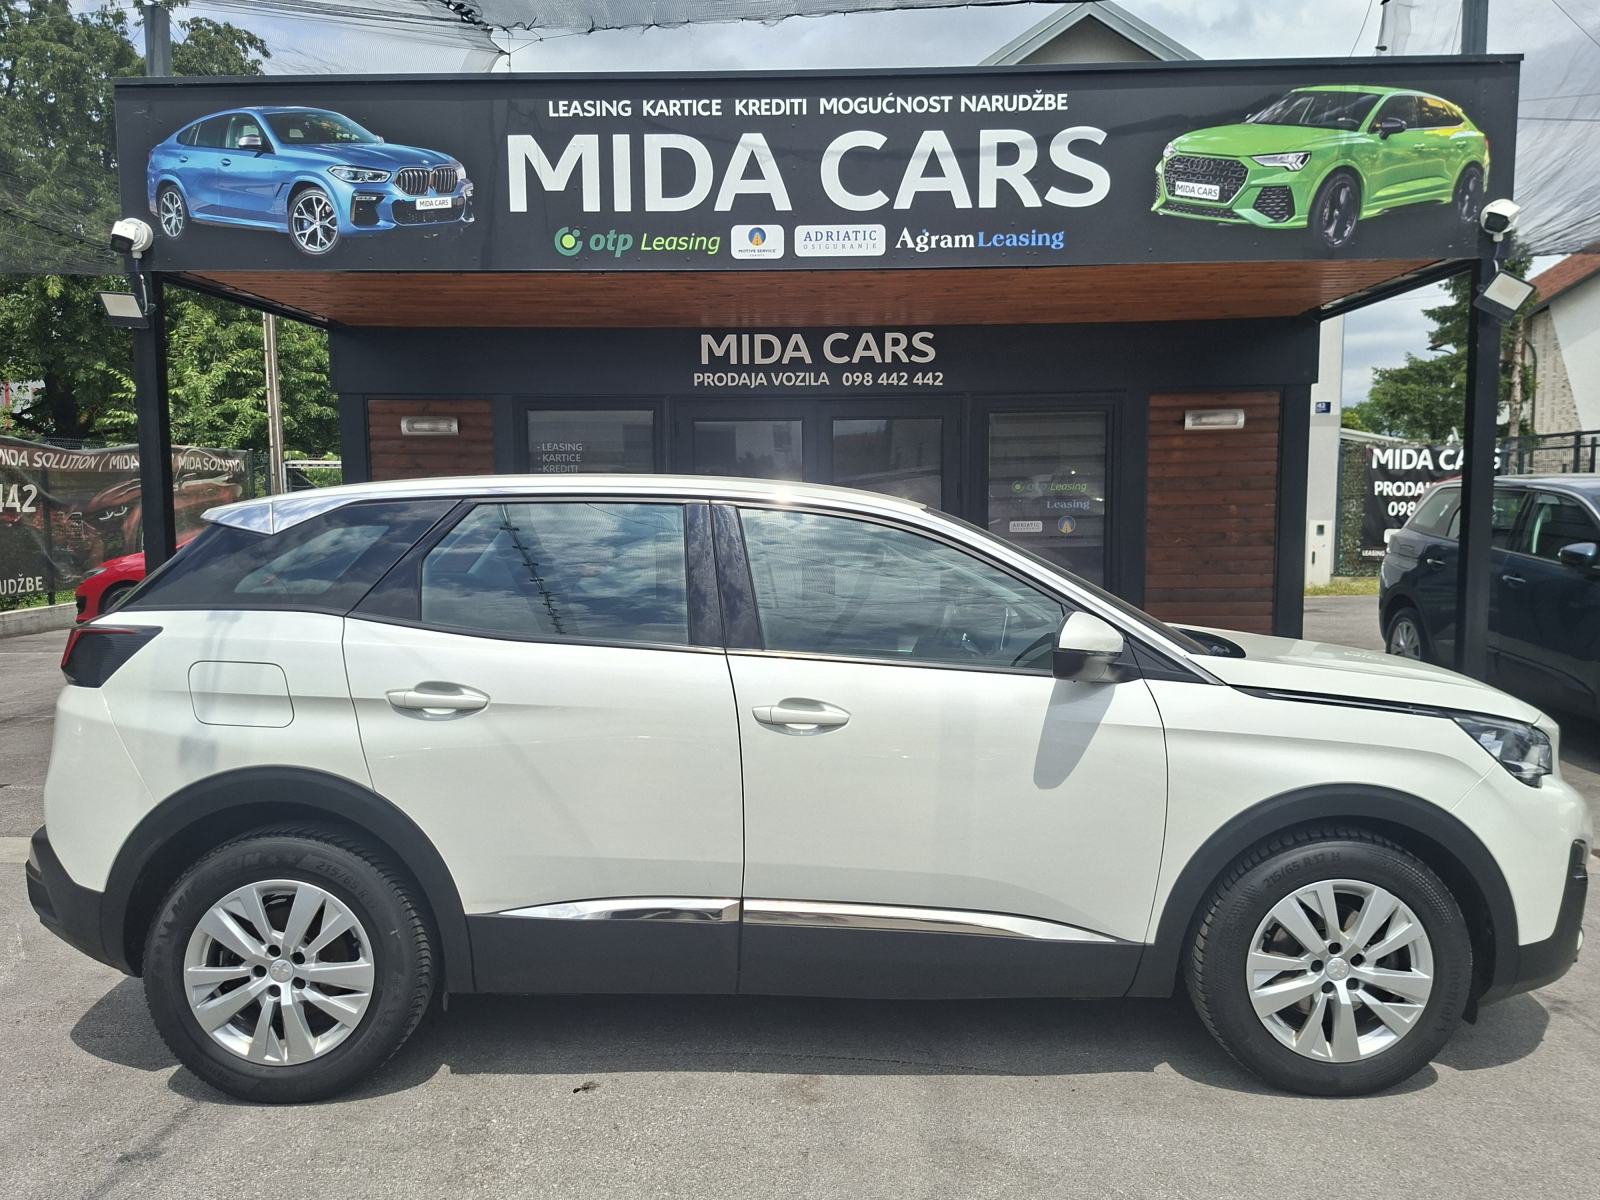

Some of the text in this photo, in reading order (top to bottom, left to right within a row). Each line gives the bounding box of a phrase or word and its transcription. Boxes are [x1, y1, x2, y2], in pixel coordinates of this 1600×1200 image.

[548, 88, 1068, 118] LEASING KARTICE KREDITI MOGUĆNOST NARUDŽBE
[507, 125, 1111, 213] MIDA CARS
[1176, 184, 1218, 197] MIDA CARS
[420, 199, 449, 208] MIDA CARS
[589, 231, 721, 258] otp Leasing
[803, 230, 877, 242] ADRIATIC
[701, 331, 936, 365] MIDA CARS
[693, 371, 944, 389] PRODAJA VOZILA 098 442 442
[33, 451, 99, 469] SOLUTION
[109, 454, 140, 470] MIDA
[178, 455, 203, 470] MIDA
[1371, 448, 1434, 470] MIDA
[1050, 482, 1088, 493] Leasing
[1046, 499, 1090, 510] Leasing
[1387, 501, 1416, 517] 098
